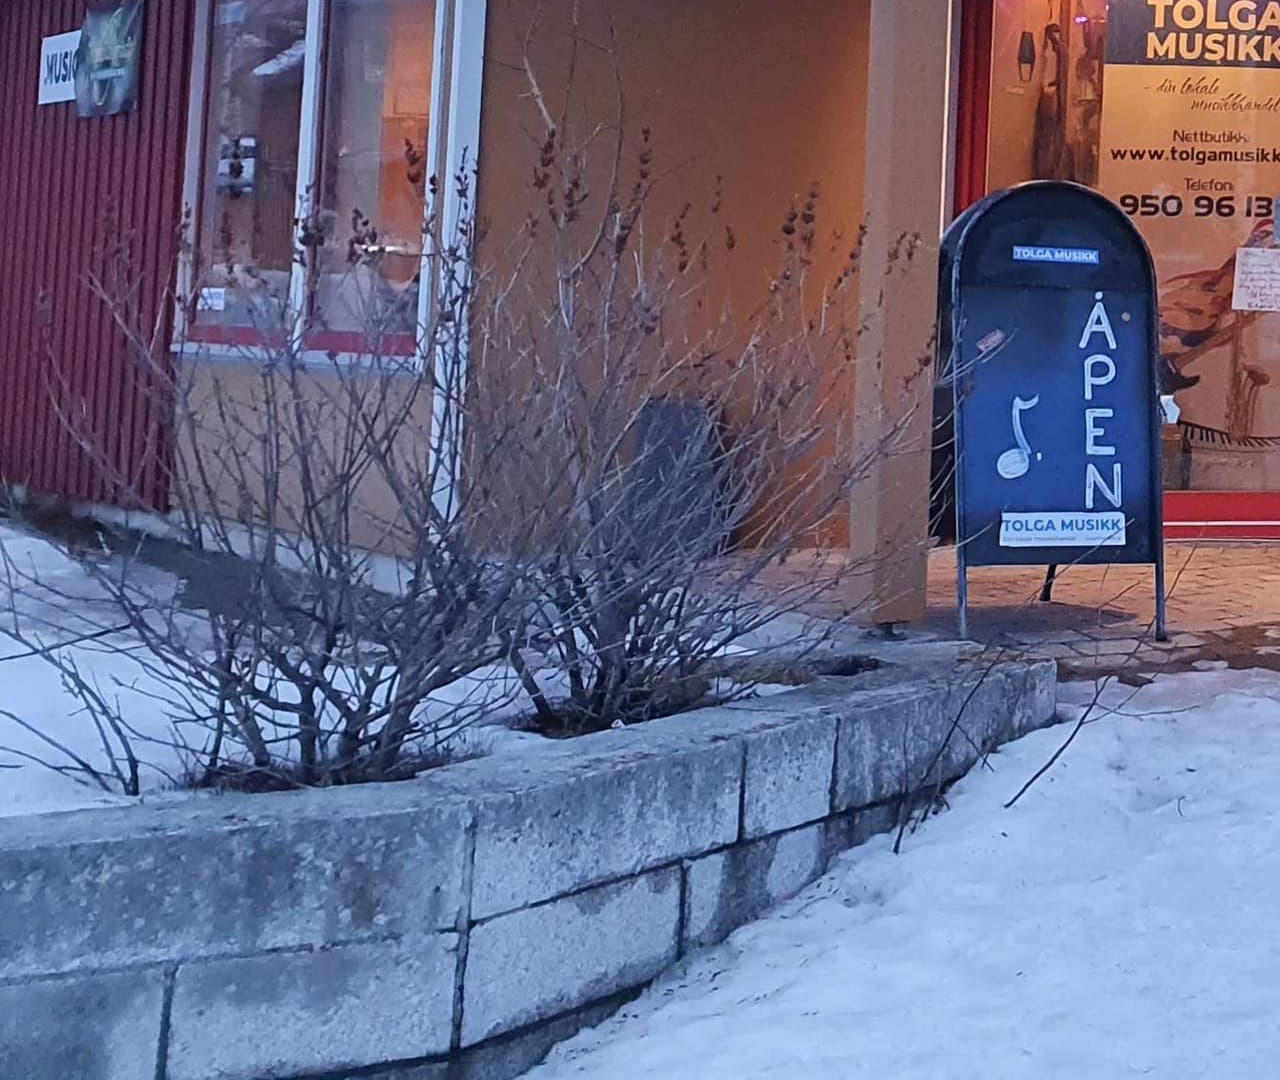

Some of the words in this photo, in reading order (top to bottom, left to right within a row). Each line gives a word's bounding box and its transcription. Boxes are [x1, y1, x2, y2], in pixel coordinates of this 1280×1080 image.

[1173, 129, 1247, 143] Nettbutikk
[1184, 177, 1235, 191] Telefon
[1119, 194, 1182, 217] 950
[1194, 195, 1235, 217] 96
[1246, 195, 1273, 217] 13
[1015, 248, 1052, 259] TOLGA
[1054, 250, 1097, 261] MUSIKK
[1079, 291, 1122, 509] ÅPEN
[1004, 520, 1056, 531] TOLGA
[1061, 519, 1121, 531] MUSIKK
